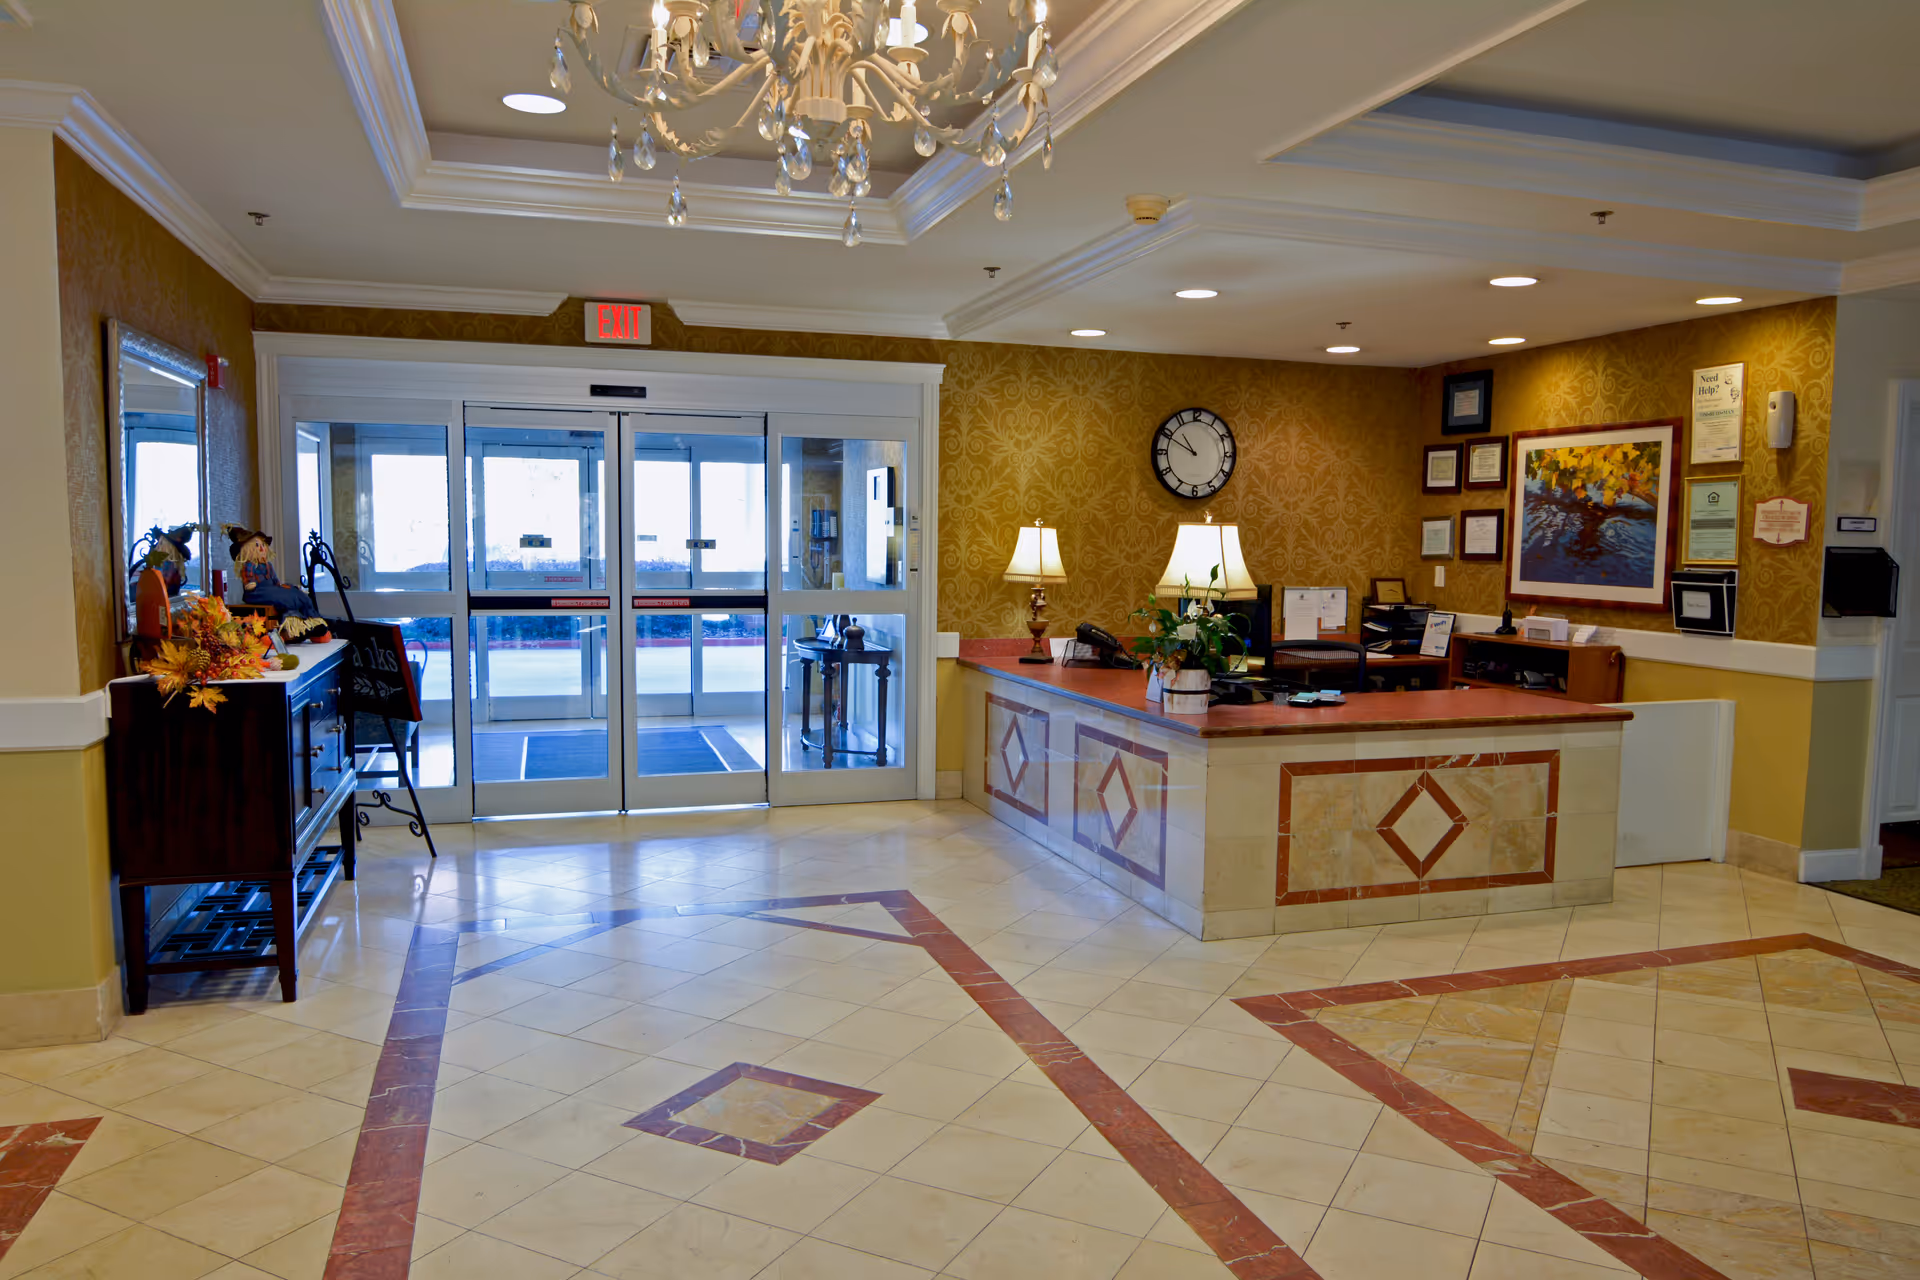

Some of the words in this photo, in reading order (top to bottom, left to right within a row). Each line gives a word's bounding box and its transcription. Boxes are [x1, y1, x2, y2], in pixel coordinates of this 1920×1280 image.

[598, 304, 641, 339] EXIT
[1701, 373, 1718, 382] Need
[1698, 384, 1720, 396] Help?
[1193, 410, 1202, 422] 12
[1191, 485, 1198, 497] 6
[1208, 480, 1216, 492] 5
